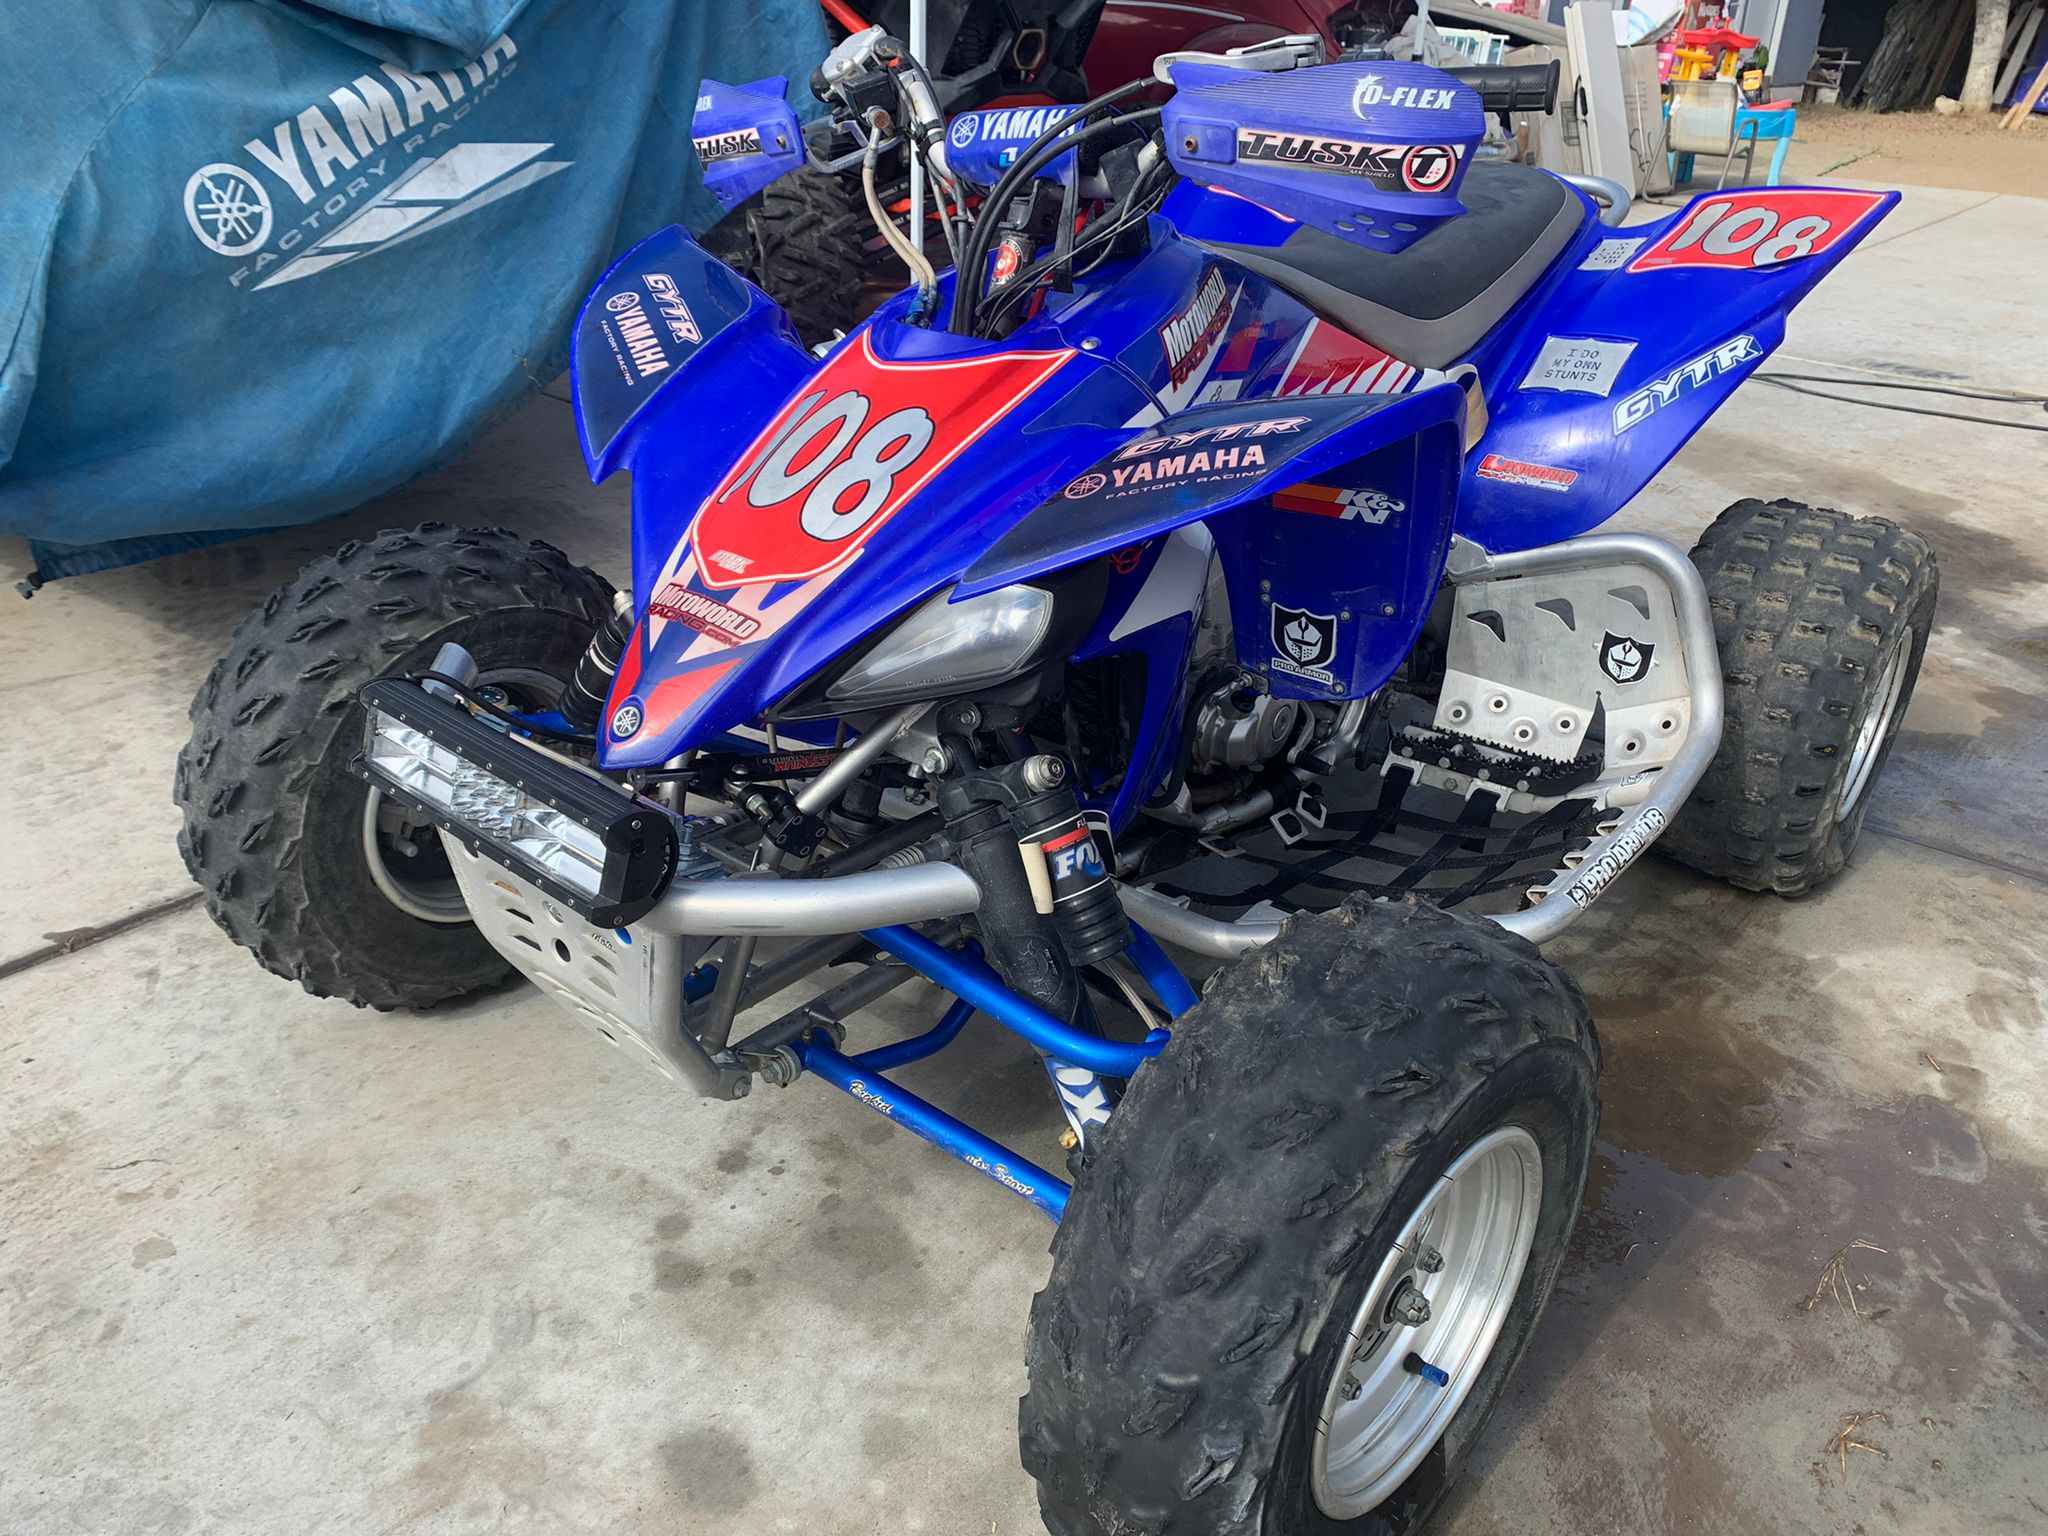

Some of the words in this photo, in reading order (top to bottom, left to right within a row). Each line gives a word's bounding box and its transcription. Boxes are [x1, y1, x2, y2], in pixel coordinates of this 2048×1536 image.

[1362, 84, 1456, 111] D-FLEX
[1246, 131, 1397, 171] TUSK
[228, 159, 386, 288] FACTORY
[1666, 202, 1832, 267] 108
[641, 273, 703, 345] GYTR
[600, 320, 619, 352] FACTORY
[616, 354, 635, 386] RACING
[614, 305, 670, 377] YAMAHA
[1566, 348, 1576, 357] I
[1580, 349, 1600, 359] DO
[1544, 369, 1597, 382] STUNTS
[1552, 359, 1569, 368] MY
[1573, 360, 1602, 371] OWN
[1612, 334, 1763, 437] GYTR
[1112, 416, 1312, 463] GYTR
[717, 389, 936, 542] 108
[1105, 480, 1189, 500] FACTORY
[1196, 468, 1269, 484] RACING
[1111, 444, 1266, 488] YAMAHA
[1335, 489, 1405, 524] K&N
[1274, 660, 1294, 671] PRO
[1294, 666, 1330, 681] ARMOR
[1055, 842, 1101, 879] FO
[1581, 855, 1619, 894] PRO
